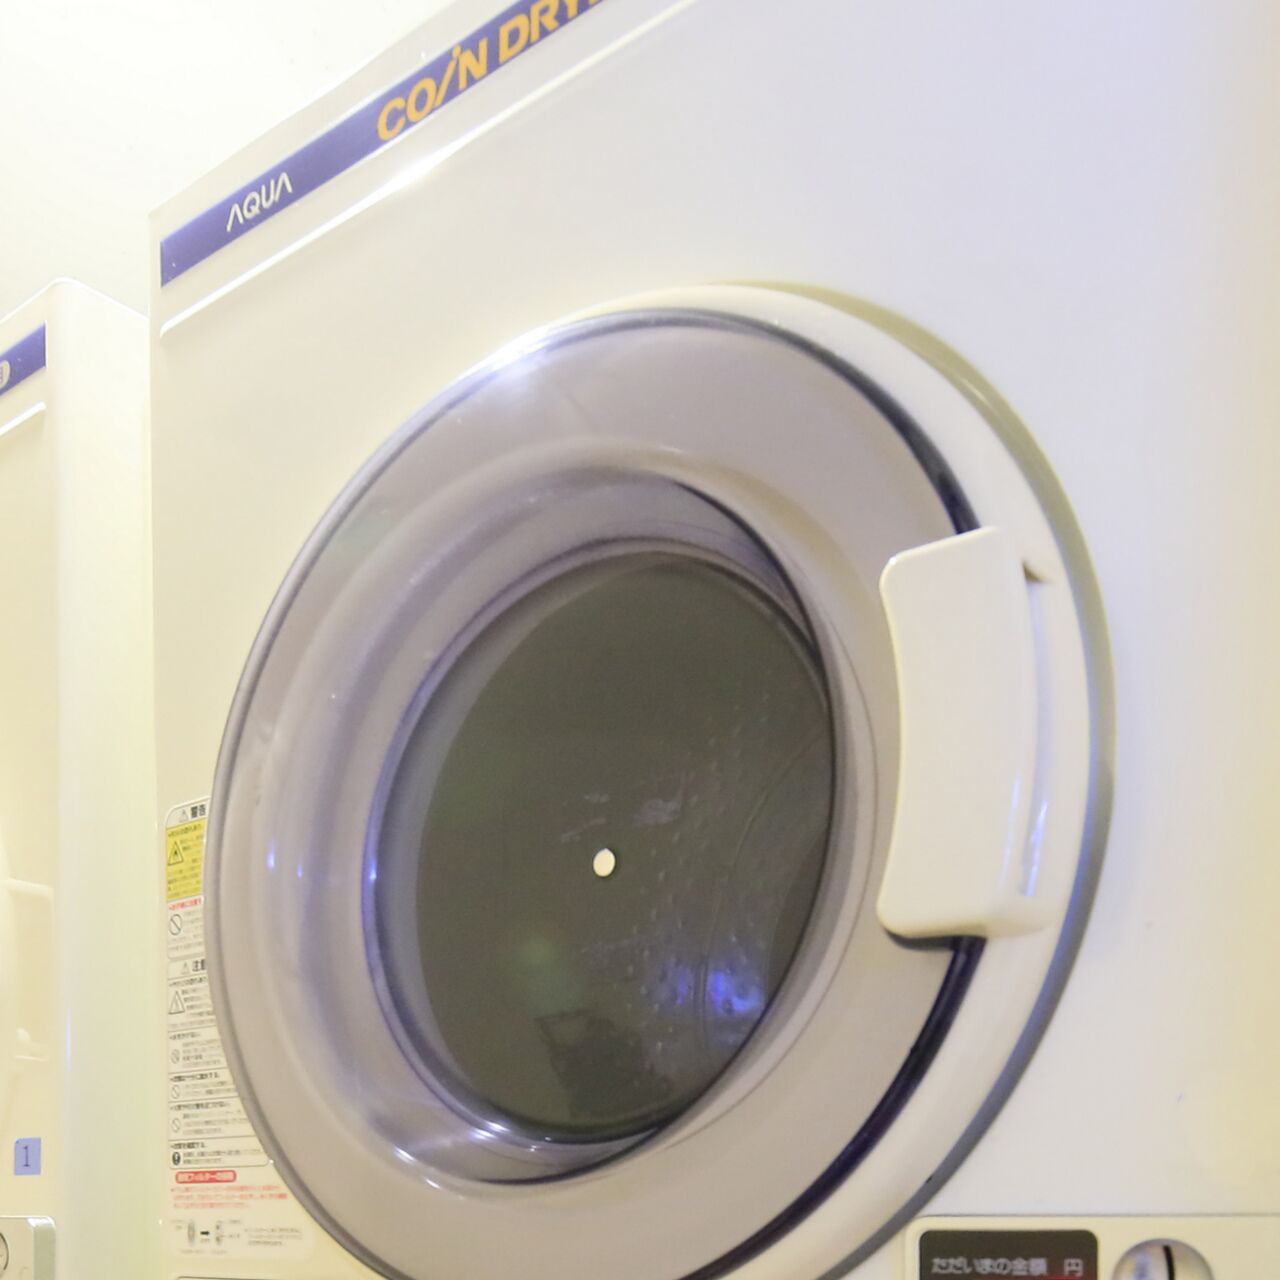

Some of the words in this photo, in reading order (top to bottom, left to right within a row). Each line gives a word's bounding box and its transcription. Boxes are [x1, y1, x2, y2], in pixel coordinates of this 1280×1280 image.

[499, 0, 604, 64] DRY
[226, 171, 293, 232] AQUA
[1064, 1258, 1084, 1276] 円
